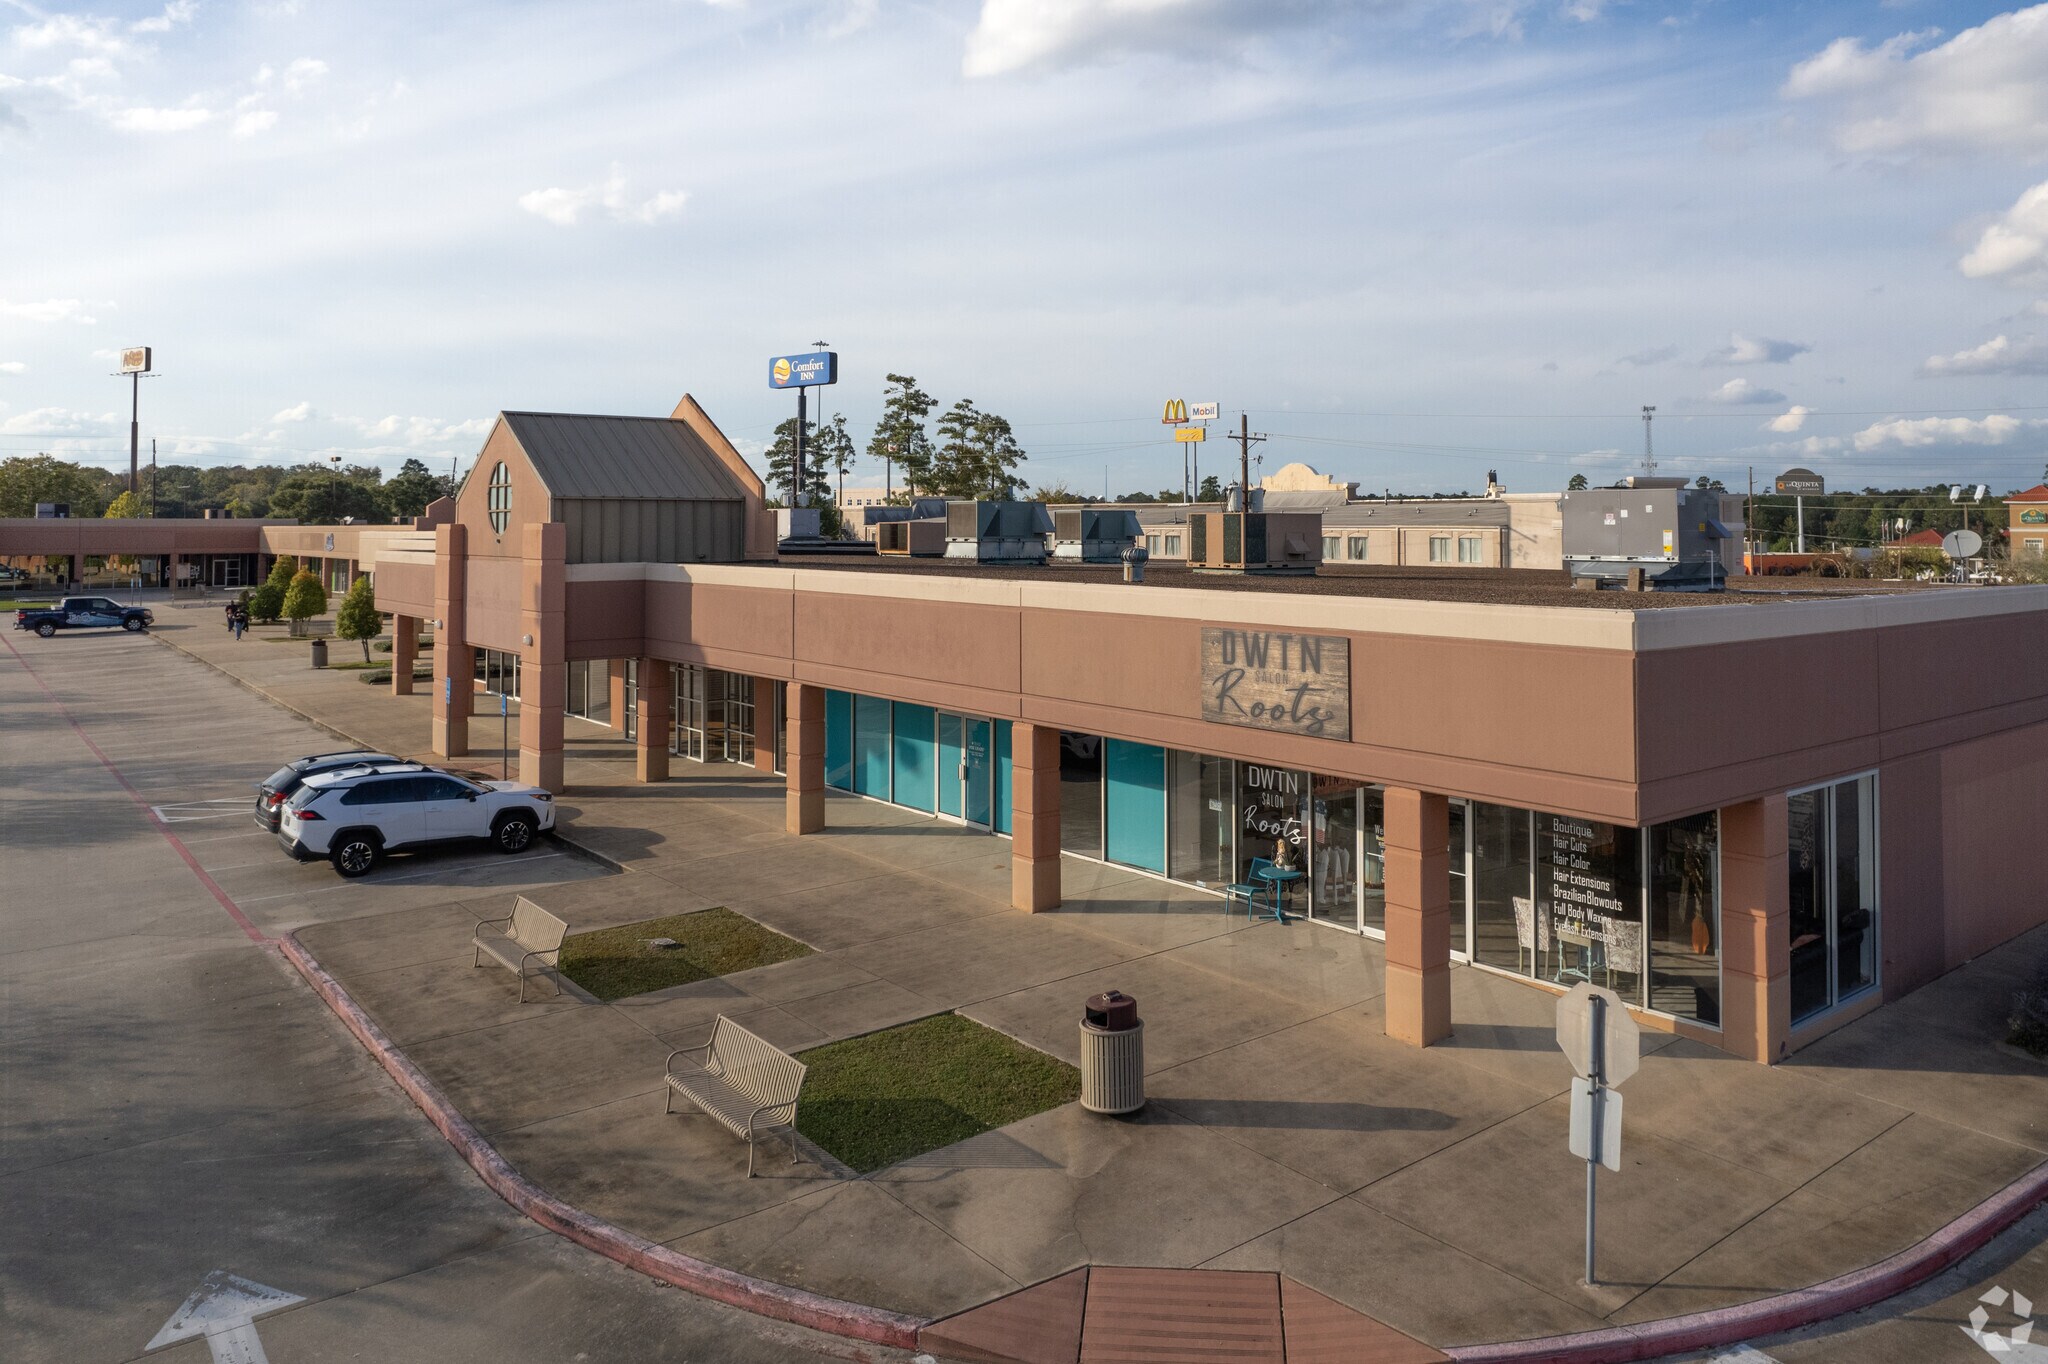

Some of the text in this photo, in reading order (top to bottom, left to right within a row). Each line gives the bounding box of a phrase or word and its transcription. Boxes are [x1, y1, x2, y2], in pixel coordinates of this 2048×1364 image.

[792, 358, 824, 372] Comfort
[800, 371, 815, 380] INN
[1192, 407, 1215, 416] Mobil
[1222, 630, 1321, 674] DWTN
[1255, 670, 1289, 685] SALON
[1212, 668, 1335, 733] Roots
[1248, 766, 1298, 795] DWTN
[1261, 792, 1284, 809] SALON
[1244, 804, 1307, 845] Roots
[1553, 818, 1592, 838] Boutique
[1553, 834, 1587, 853] Hair Cuts
[1553, 850, 1591, 870] Hair Color
[1553, 867, 1610, 892] Hair Extensions
[1553, 884, 1623, 912] Brazilian Blowouts
[1553, 901, 1612, 928] Full Body Waxing
[1581, 924, 1617, 945] Extensions
